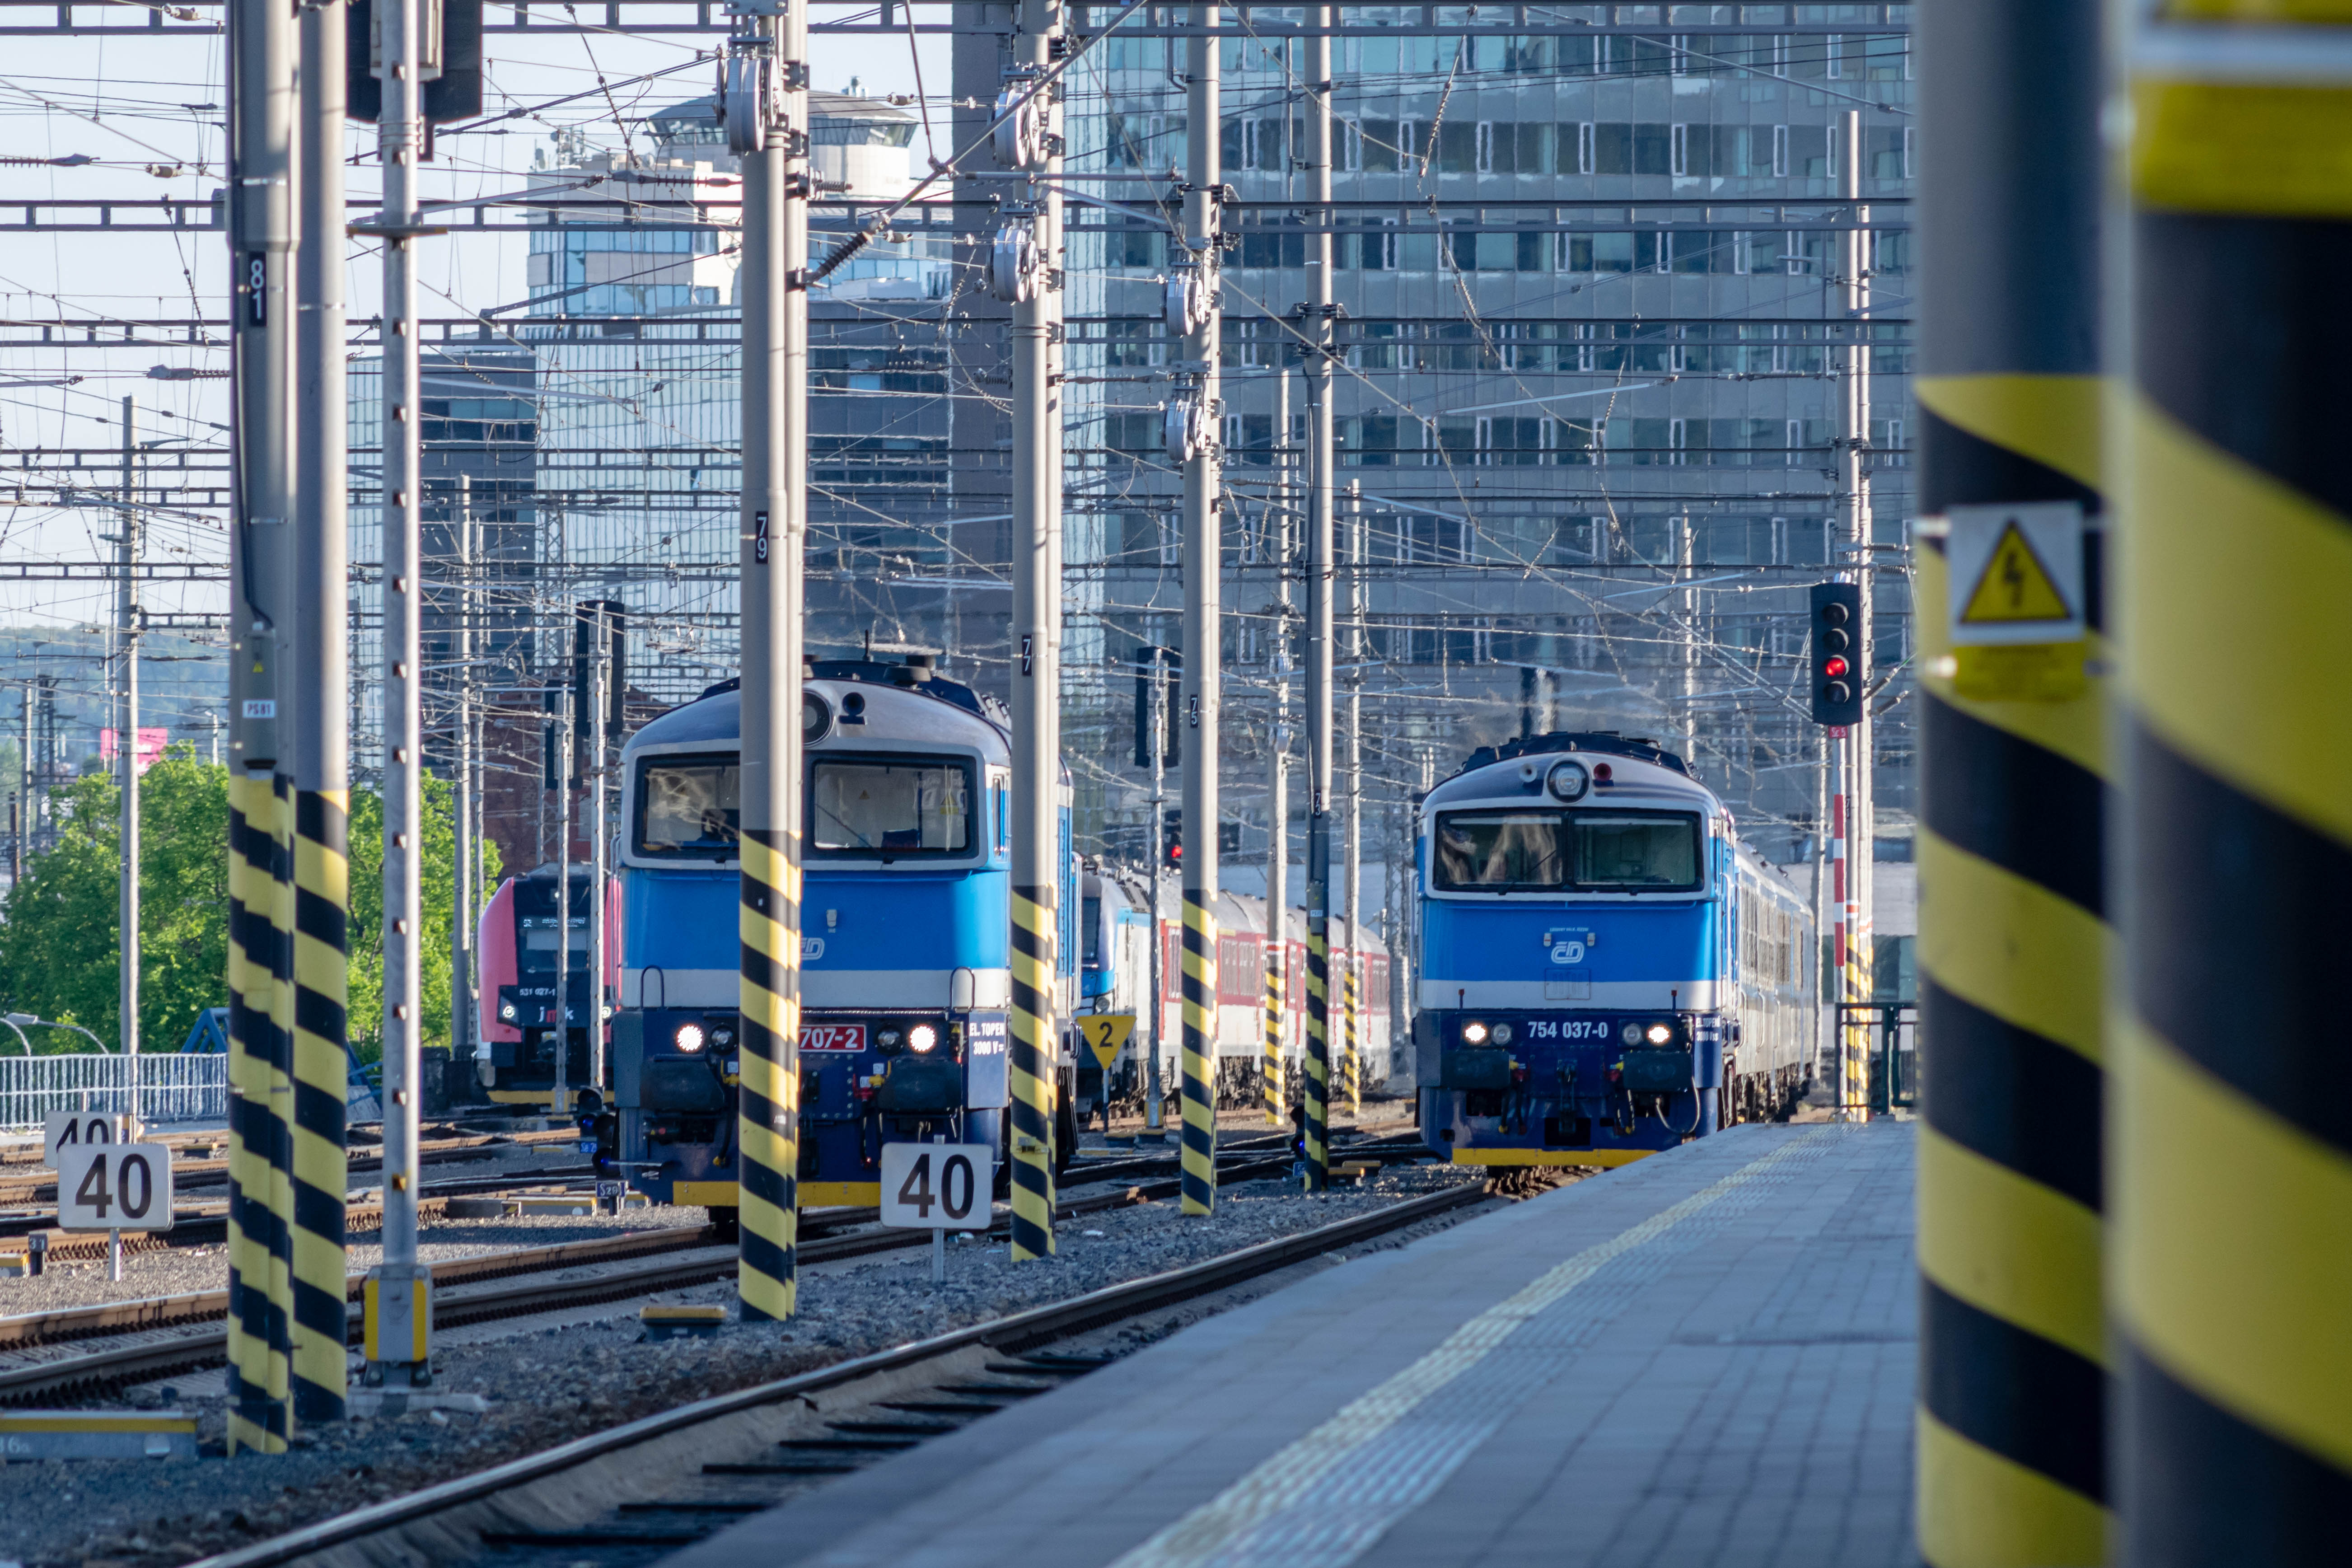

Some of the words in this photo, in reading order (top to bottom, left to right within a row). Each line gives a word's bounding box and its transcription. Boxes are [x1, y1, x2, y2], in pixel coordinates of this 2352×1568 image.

[251, 259, 264, 319] 81
[757, 516, 767, 558] 79
[1023, 638, 1031, 671] 77
[1191, 697, 1197, 725] 75
[1315, 792, 1320, 815] 73
[800, 1028, 858, 1048] 707-2
[1099, 1021, 1113, 1048] 2
[1528, 1021, 1557, 1038] 754
[1562, 1021, 1609, 1039] 037-0
[973, 1041, 991, 1055] 3000
[76, 1153, 152, 1219] 40
[898, 1153, 974, 1220] 40
